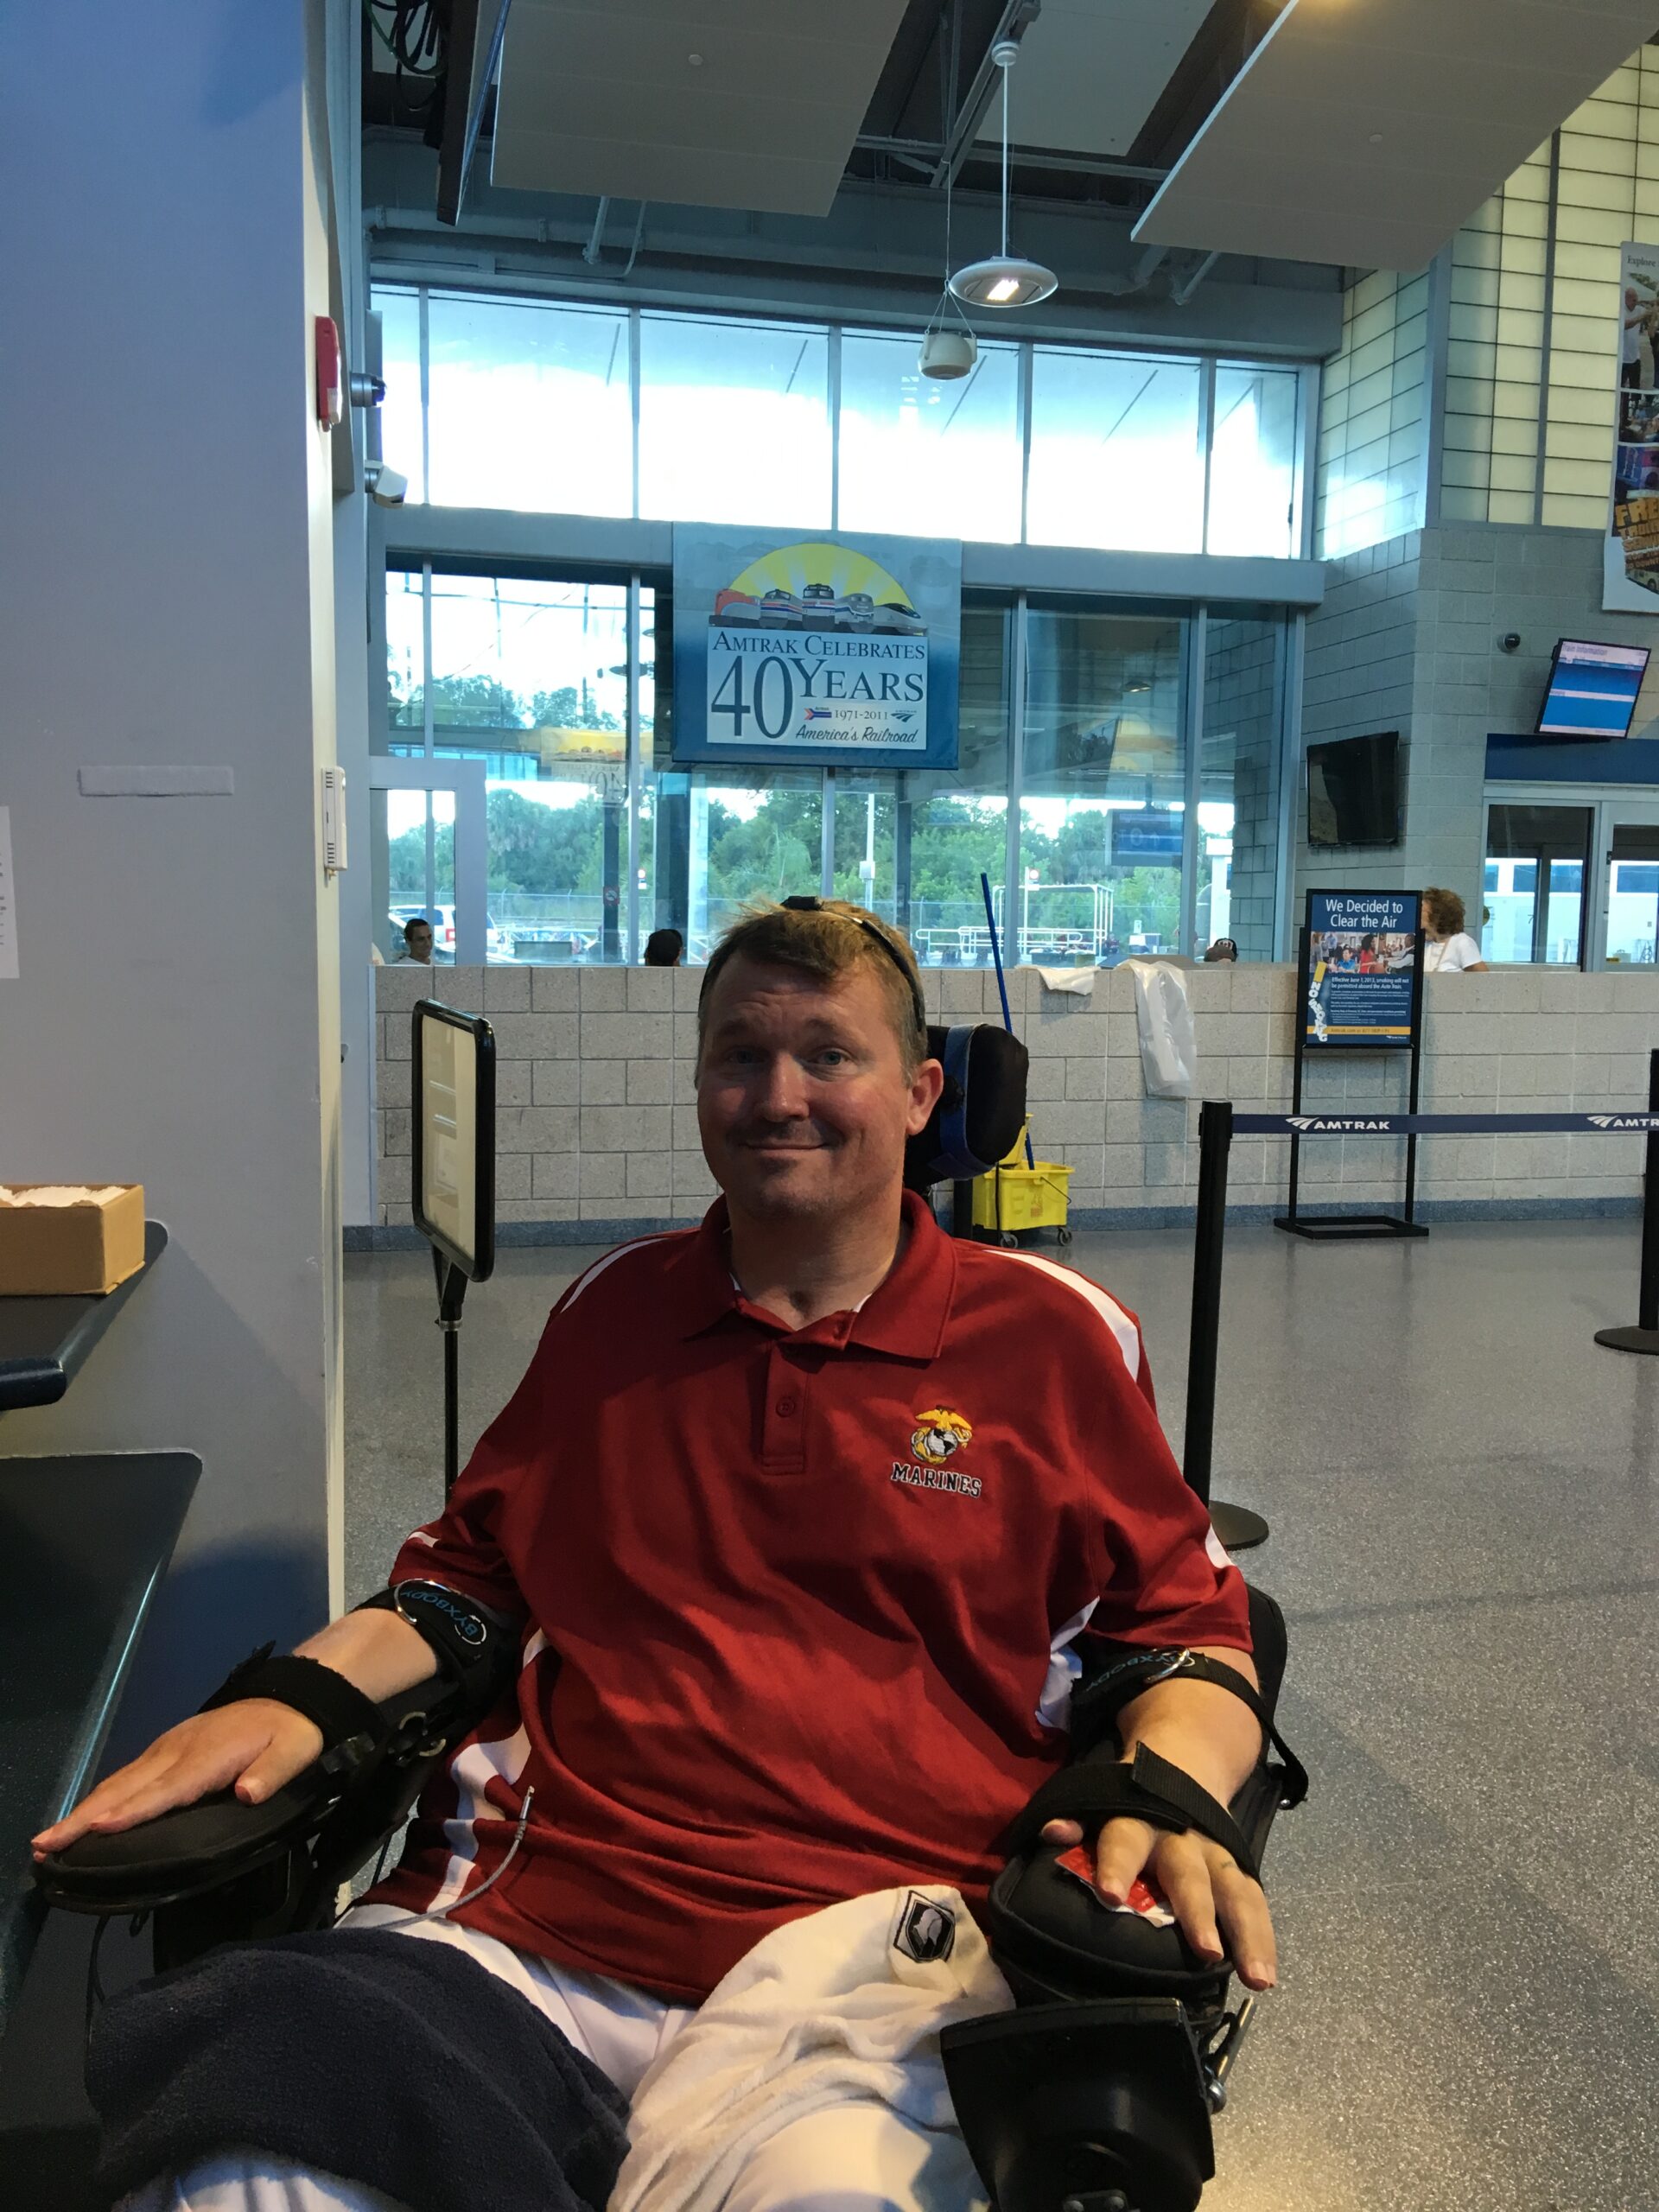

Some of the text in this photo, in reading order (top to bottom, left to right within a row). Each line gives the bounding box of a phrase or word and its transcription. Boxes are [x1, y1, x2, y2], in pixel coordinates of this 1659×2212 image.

[804, 635, 925, 659] CELEBRATES
[711, 655, 925, 739] 40 YEARS
[835, 709, 888, 721] 1971-2011
[796, 724, 918, 744] America's Railroad
[1325, 899, 1403, 913] We Decided to
[1330, 913, 1397, 928] Clear the Air
[1313, 1120, 1390, 1130] AMTRAK
[891, 1462, 982, 1498] MARINES
[400, 1590, 479, 1637] BYXBODY
